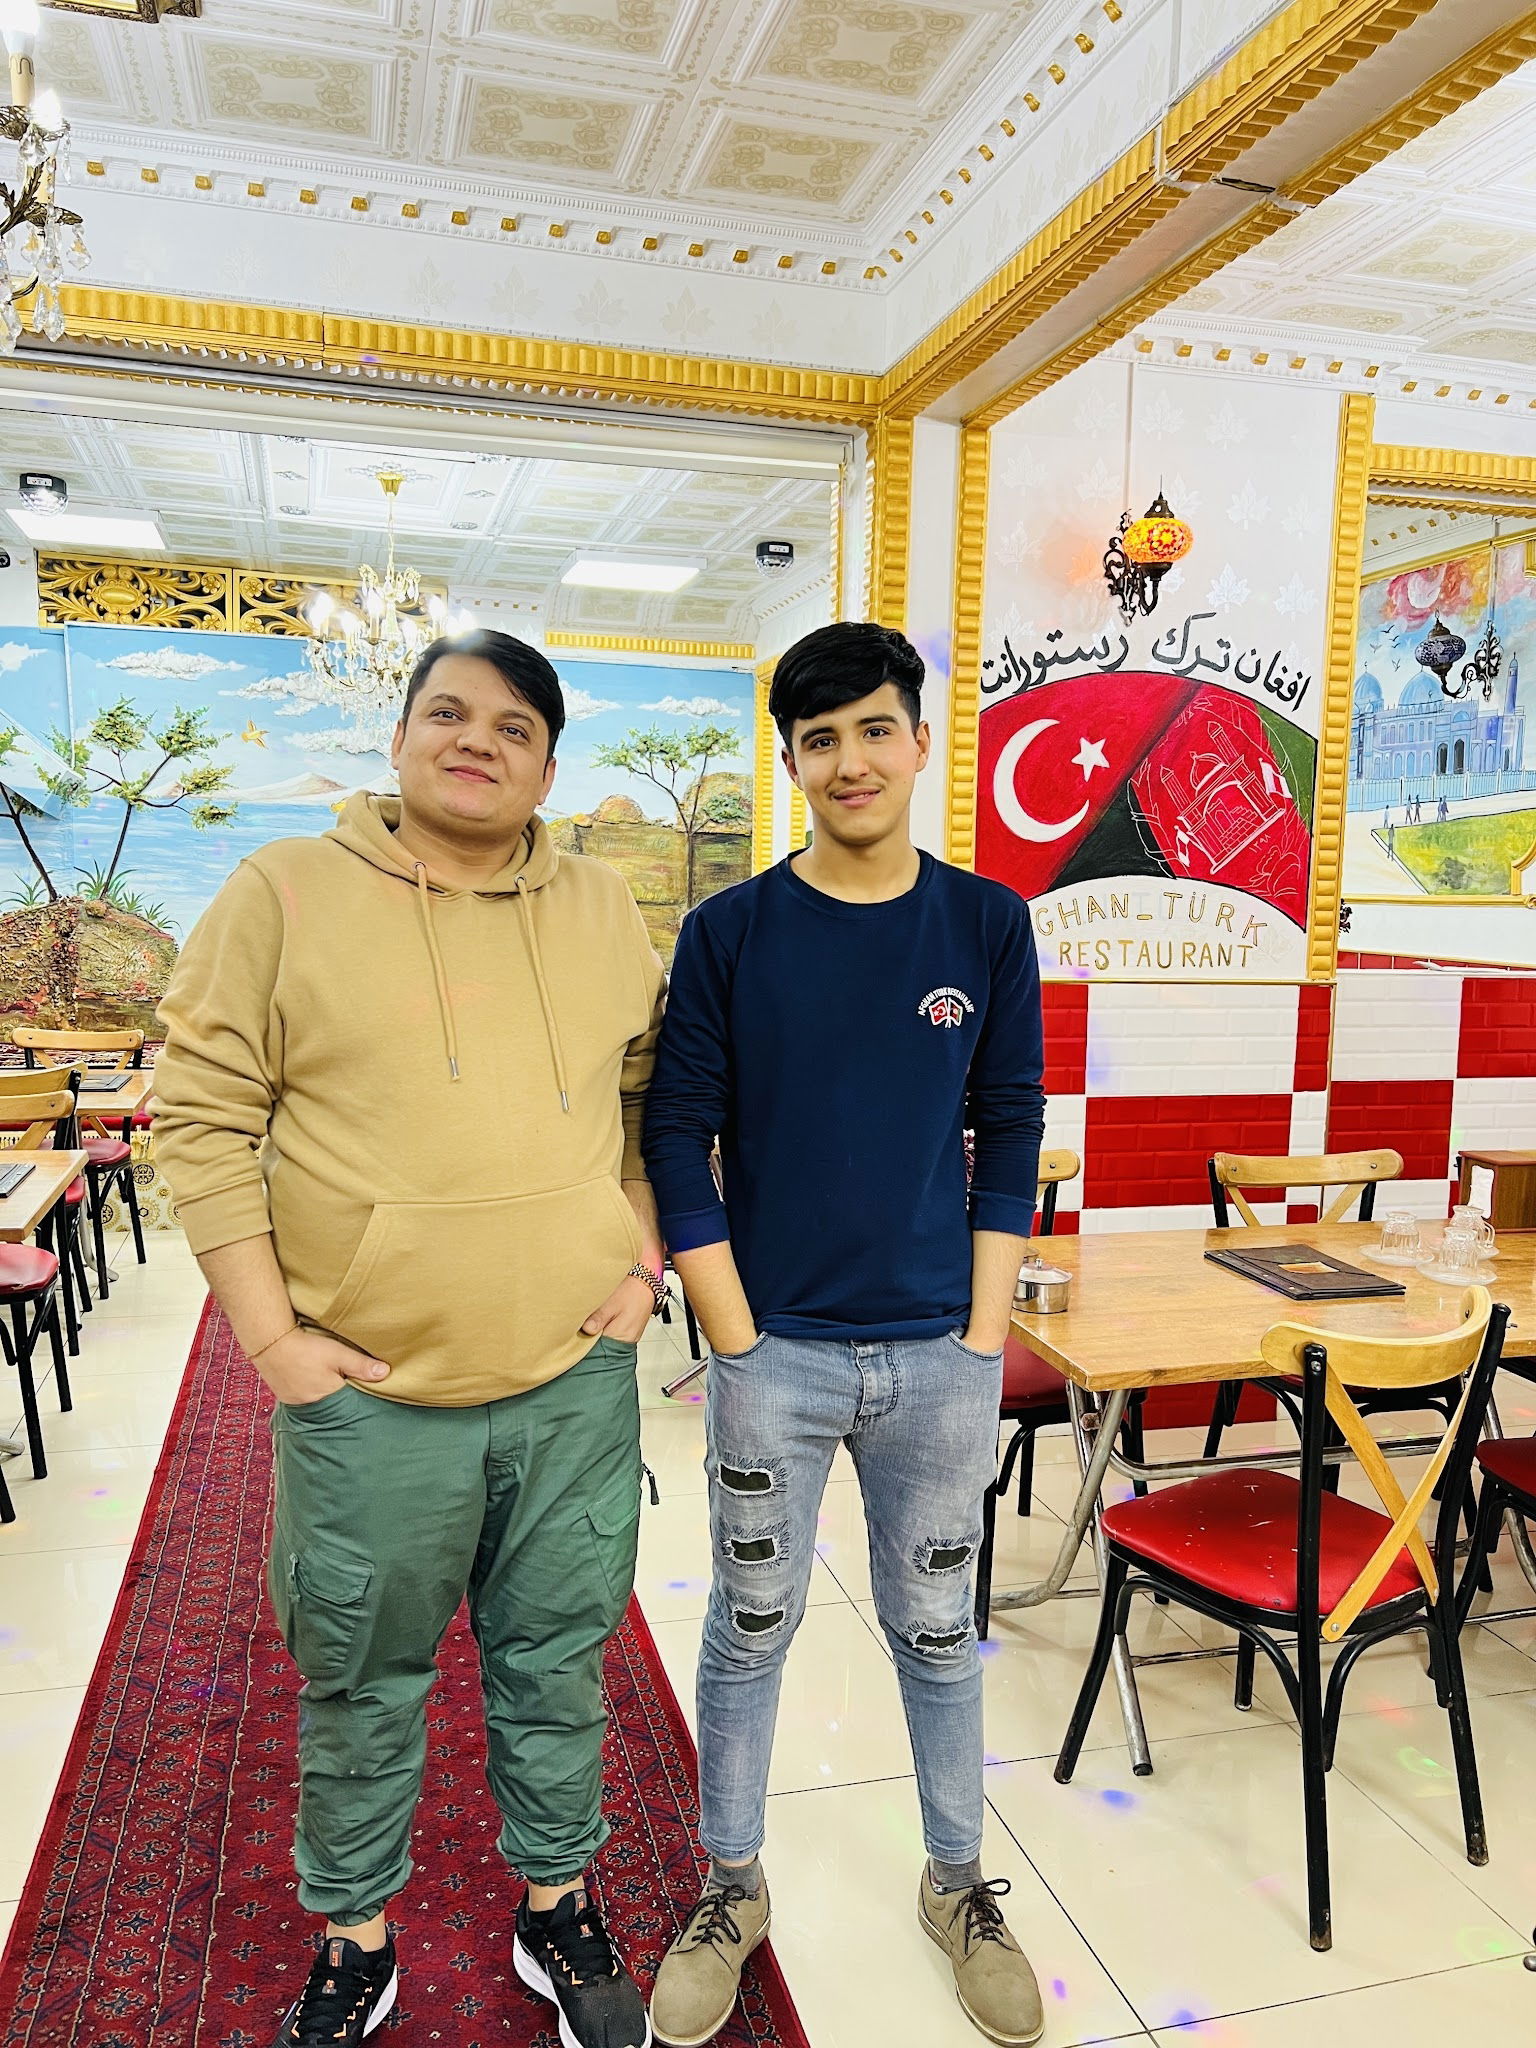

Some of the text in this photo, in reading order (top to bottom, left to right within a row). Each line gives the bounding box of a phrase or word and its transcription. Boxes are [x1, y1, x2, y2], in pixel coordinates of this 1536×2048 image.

[980, 629, 1130, 695] رستورانت
[1234, 648, 1312, 713] افغان
[1034, 891, 1268, 947] GHAN_TÜRK
[1058, 939, 1254, 971] RESTAURANT
